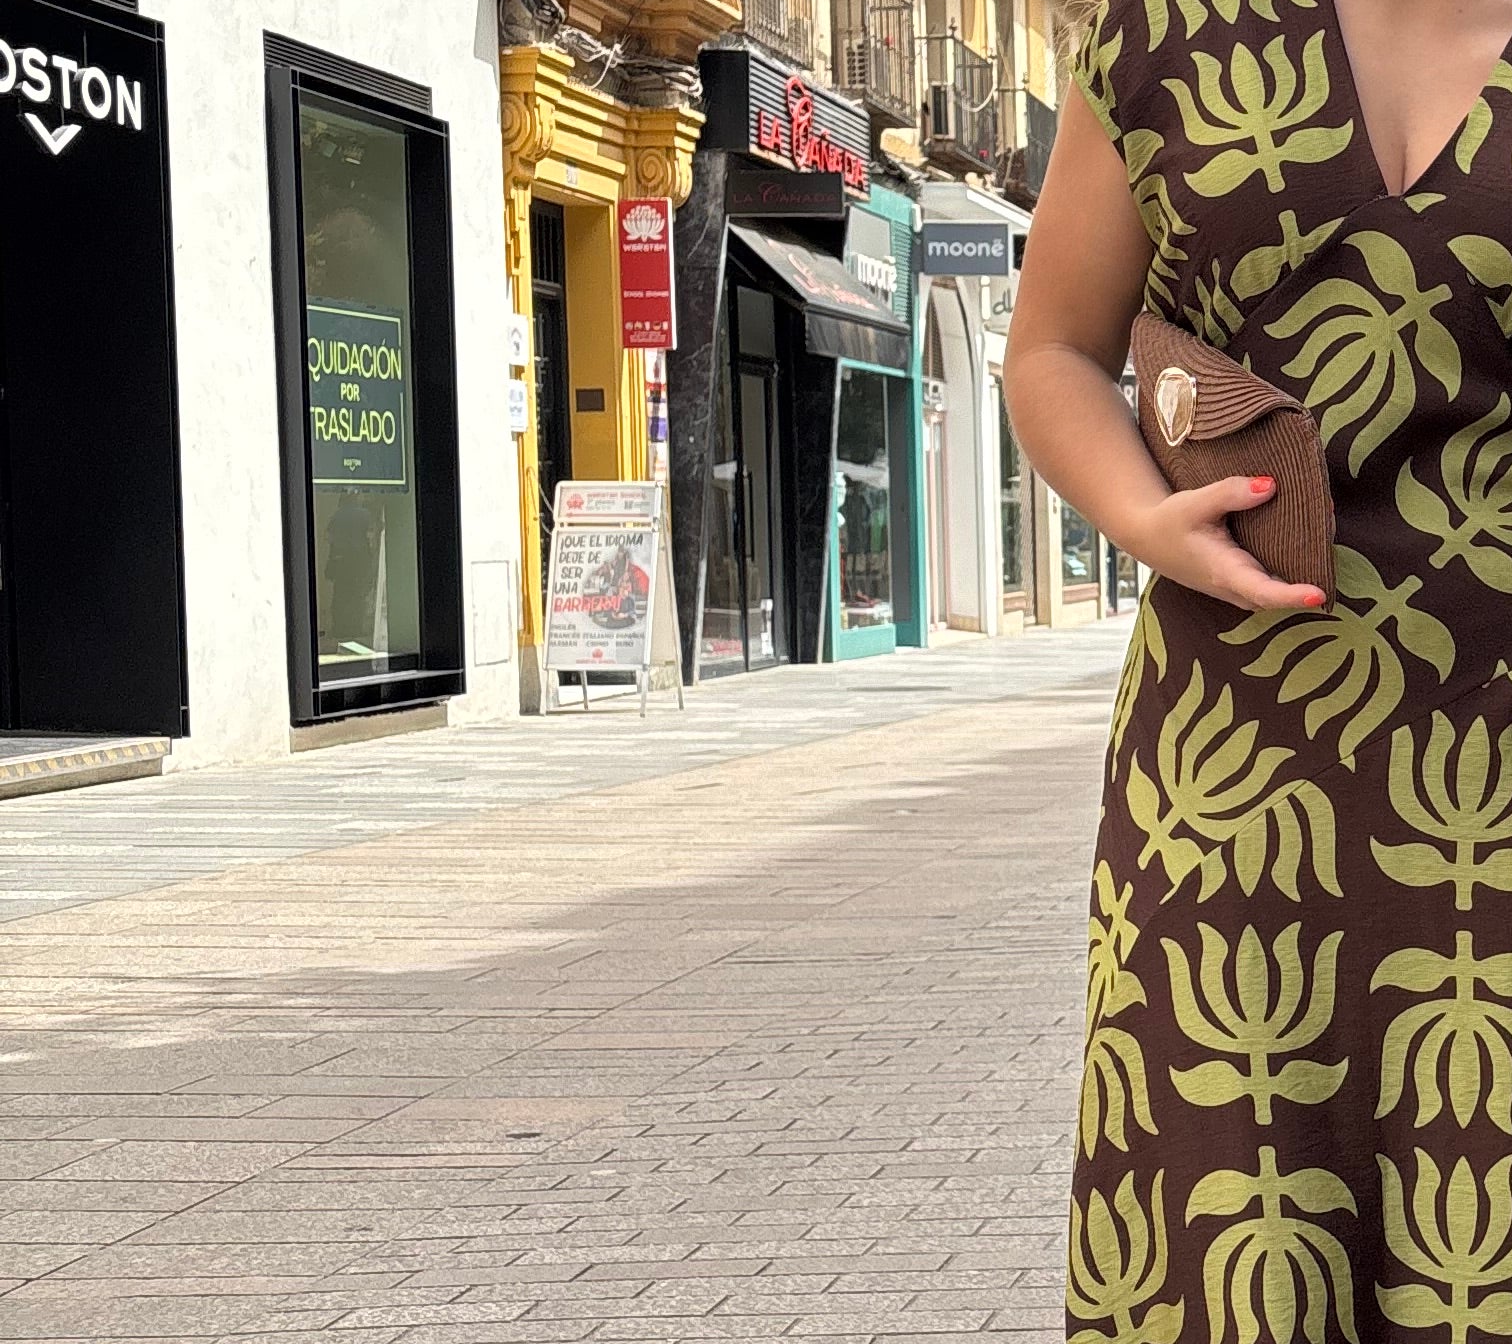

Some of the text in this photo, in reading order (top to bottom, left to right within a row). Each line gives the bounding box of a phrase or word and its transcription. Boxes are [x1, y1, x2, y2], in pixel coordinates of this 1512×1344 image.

[758, 110, 782, 150] LA
[340, 382, 360, 402] POR
[589, 535, 602, 548] EL
[605, 533, 643, 547] IDIOMA
[559, 550, 602, 564] DEJE DE
[561, 566, 583, 579] SER
[554, 582, 578, 594] UNA
